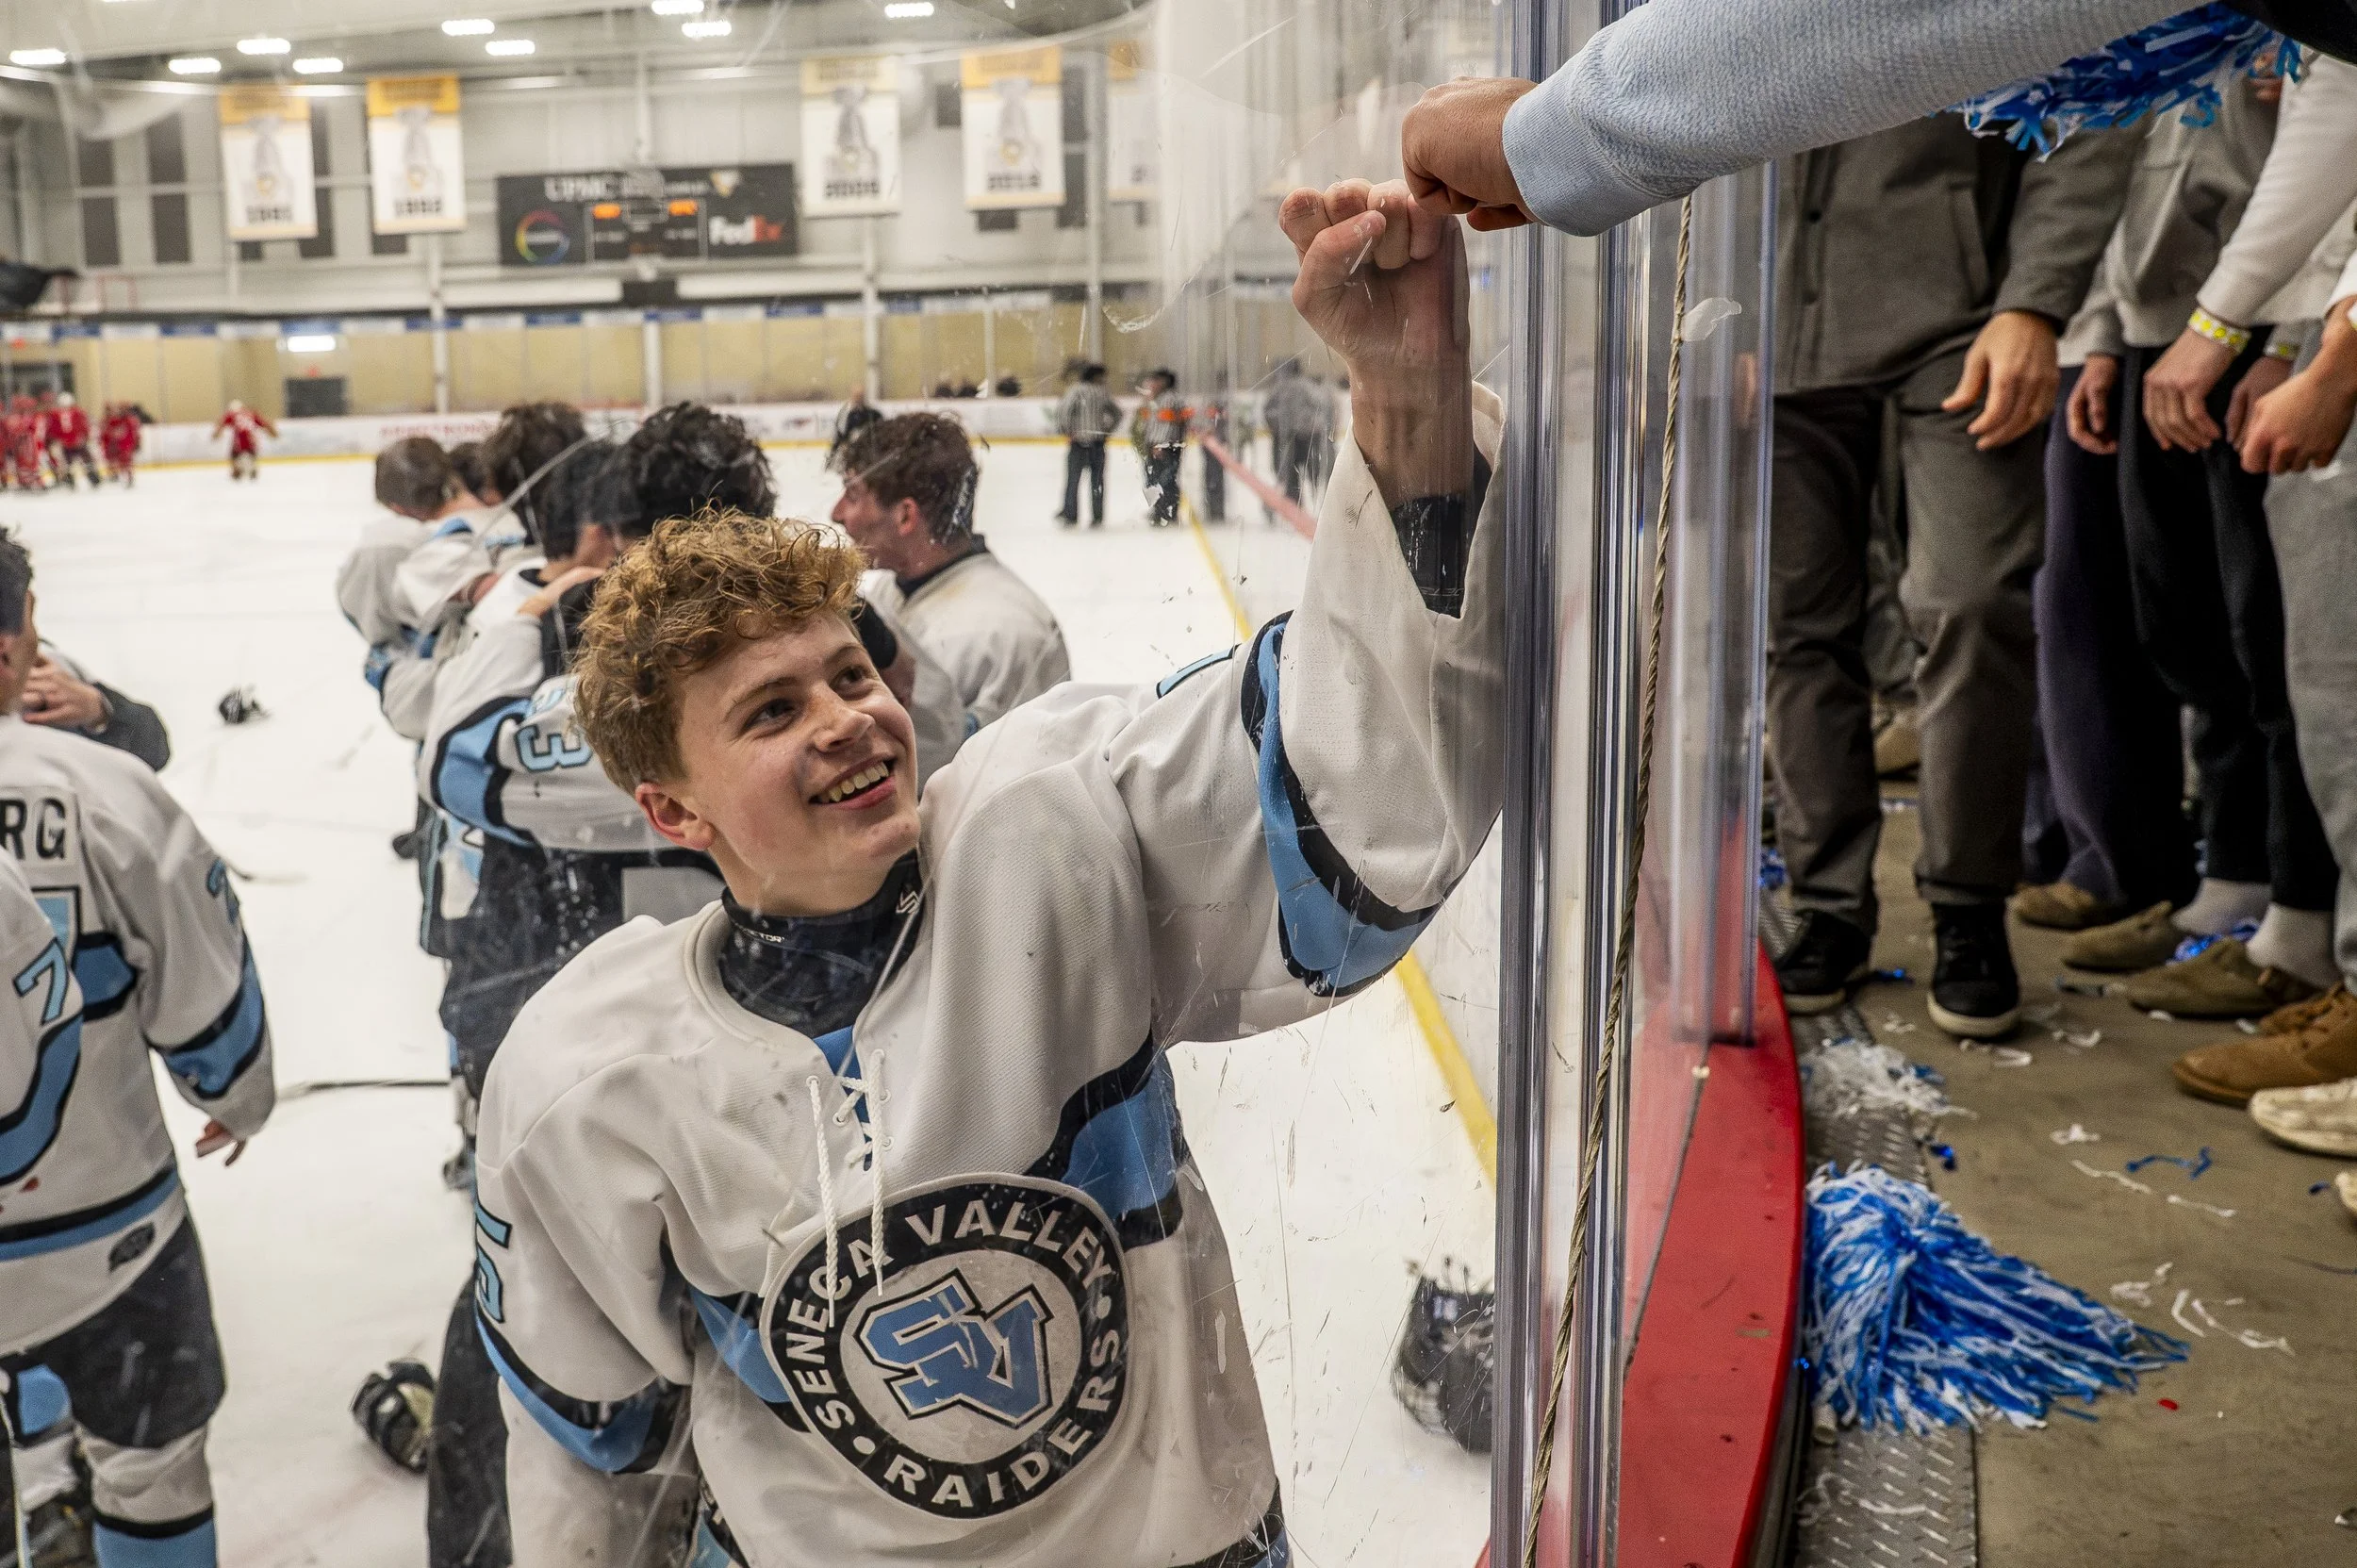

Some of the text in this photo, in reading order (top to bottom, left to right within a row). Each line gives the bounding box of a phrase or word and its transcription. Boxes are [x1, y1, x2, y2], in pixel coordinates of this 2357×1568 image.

[708, 214, 784, 245] FedEx
[786, 1198, 1113, 1431] SENECA VALLEY
[883, 1327, 1121, 1509] RAIDERS
